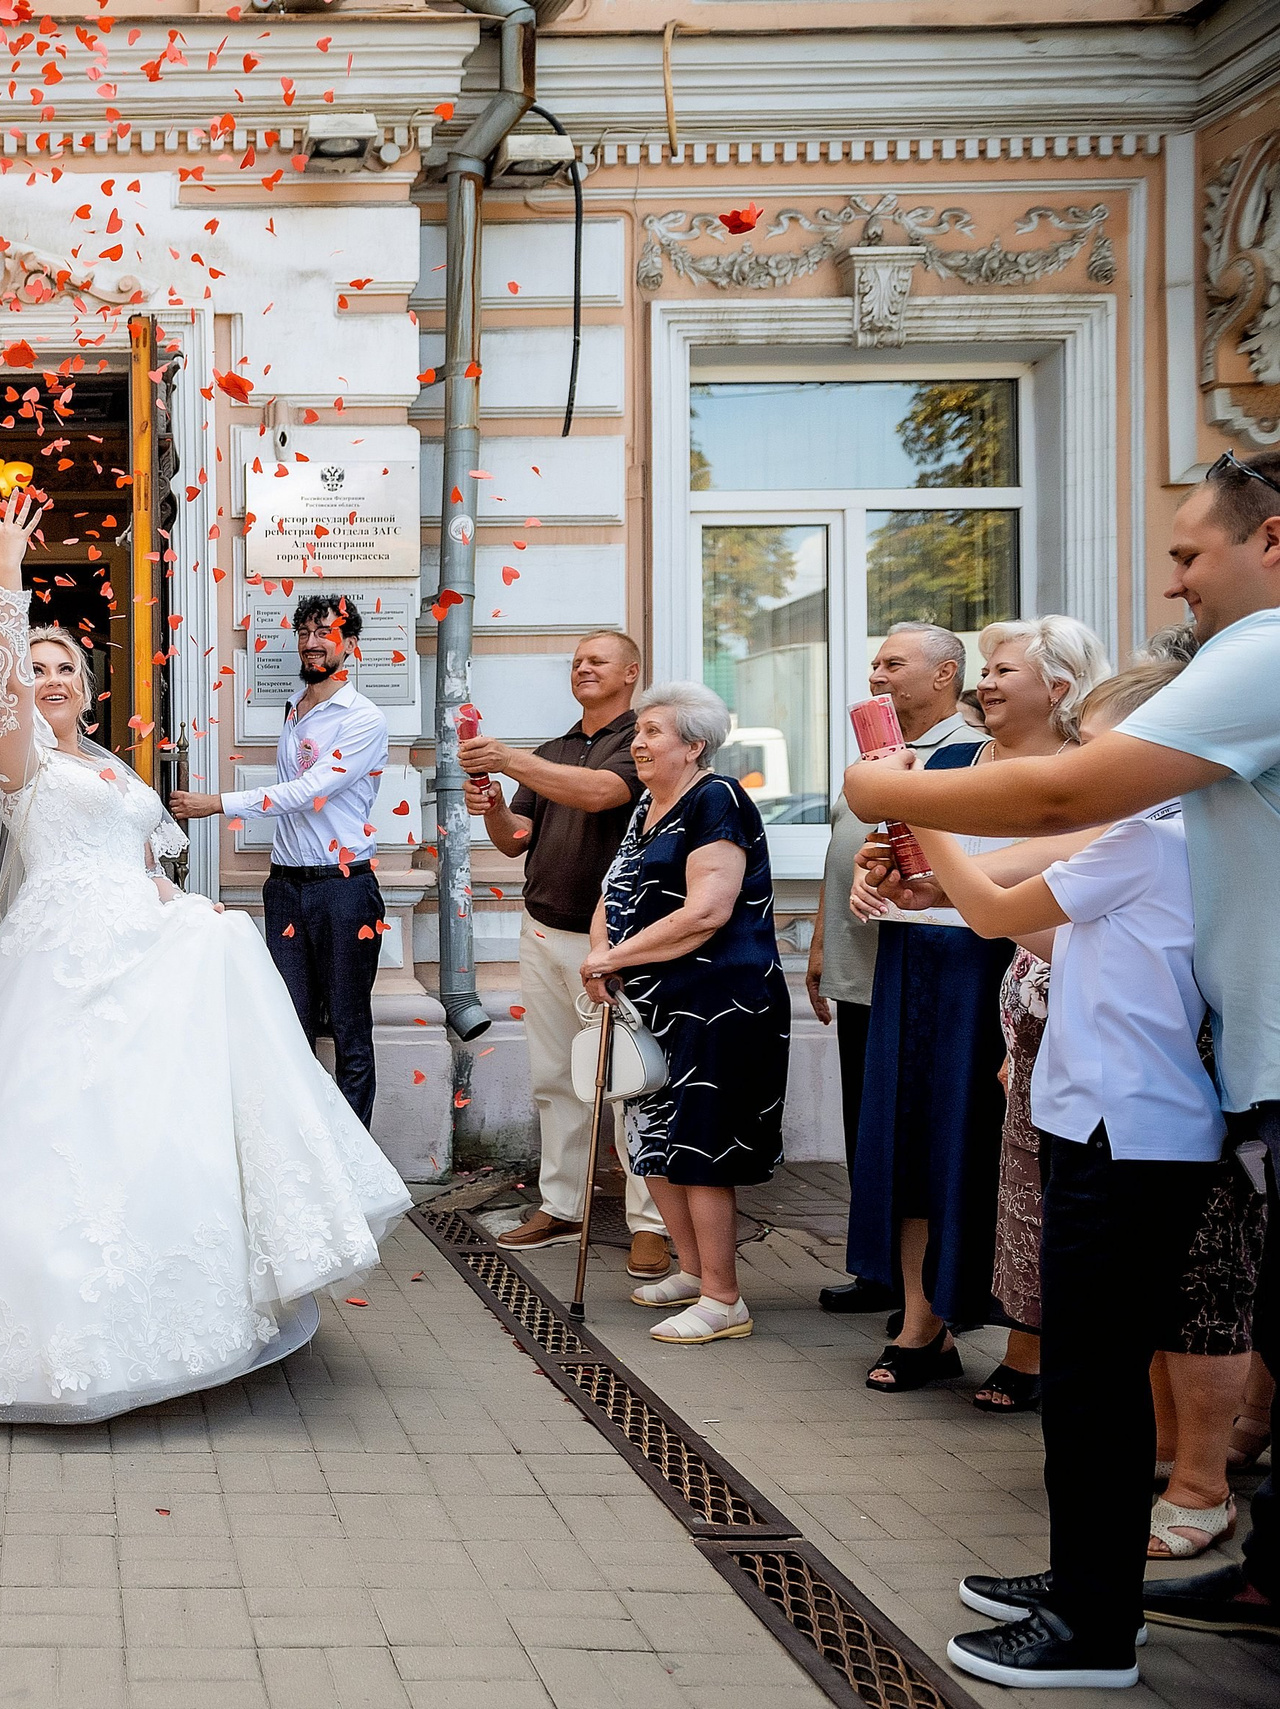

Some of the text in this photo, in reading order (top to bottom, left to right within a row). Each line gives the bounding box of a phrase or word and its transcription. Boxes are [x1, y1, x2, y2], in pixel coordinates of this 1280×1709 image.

[271, 514, 396, 525] Сктор государтвенной
[332, 526, 370, 537] Отдела
[372, 526, 402, 536] ЗАГС
[291, 540, 375, 550] Адинистрации
[313, 551, 391, 562] Новочеркасска
